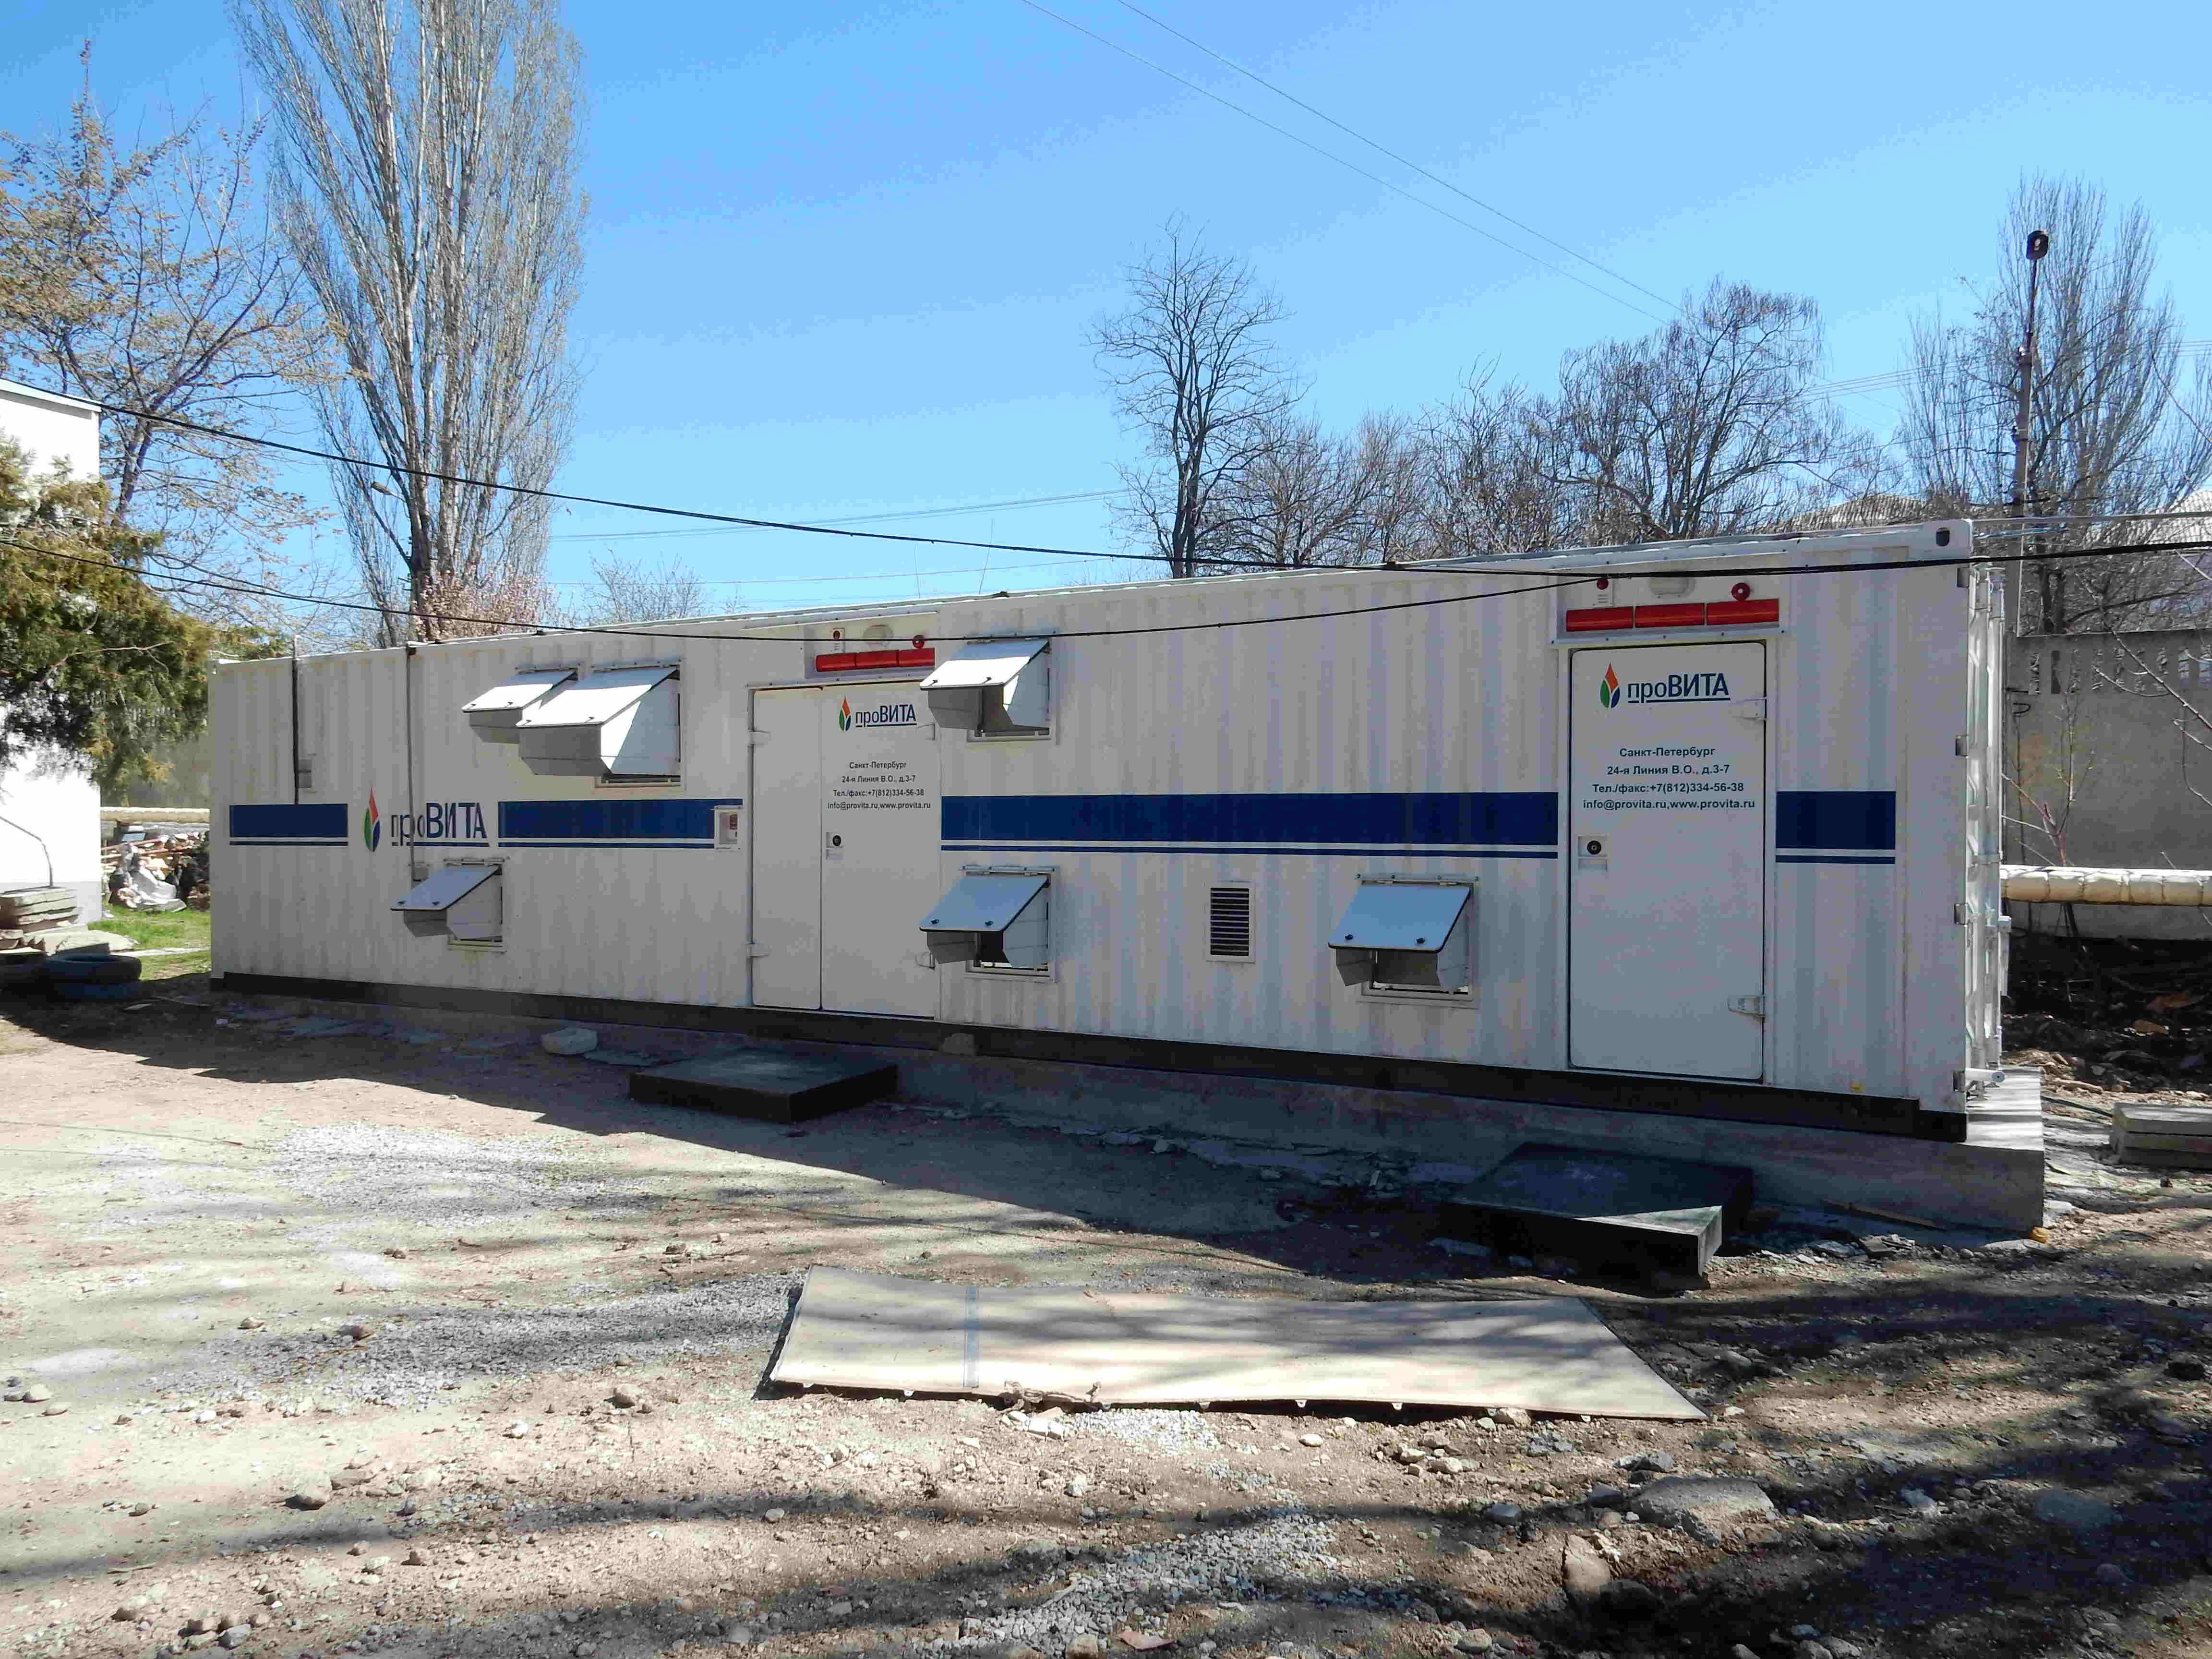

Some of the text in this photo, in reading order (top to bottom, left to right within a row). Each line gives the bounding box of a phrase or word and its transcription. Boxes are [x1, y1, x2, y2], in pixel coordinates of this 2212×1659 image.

[1628, 672, 1730, 703] проВИТА
[855, 704, 917, 727] проВИТА
[1619, 746, 1716, 758] Санкт-Петербург
[849, 761, 907, 770] Санкт-Петербург
[1607, 766, 1630, 775] 24-я
[1633, 765, 1668, 775] Линия
[1701, 764, 1730, 776] д.3-7
[1592, 782, 1744, 795] Тел./факс:+7(812)334-56-38
[391, 802, 487, 846] проВИТА
